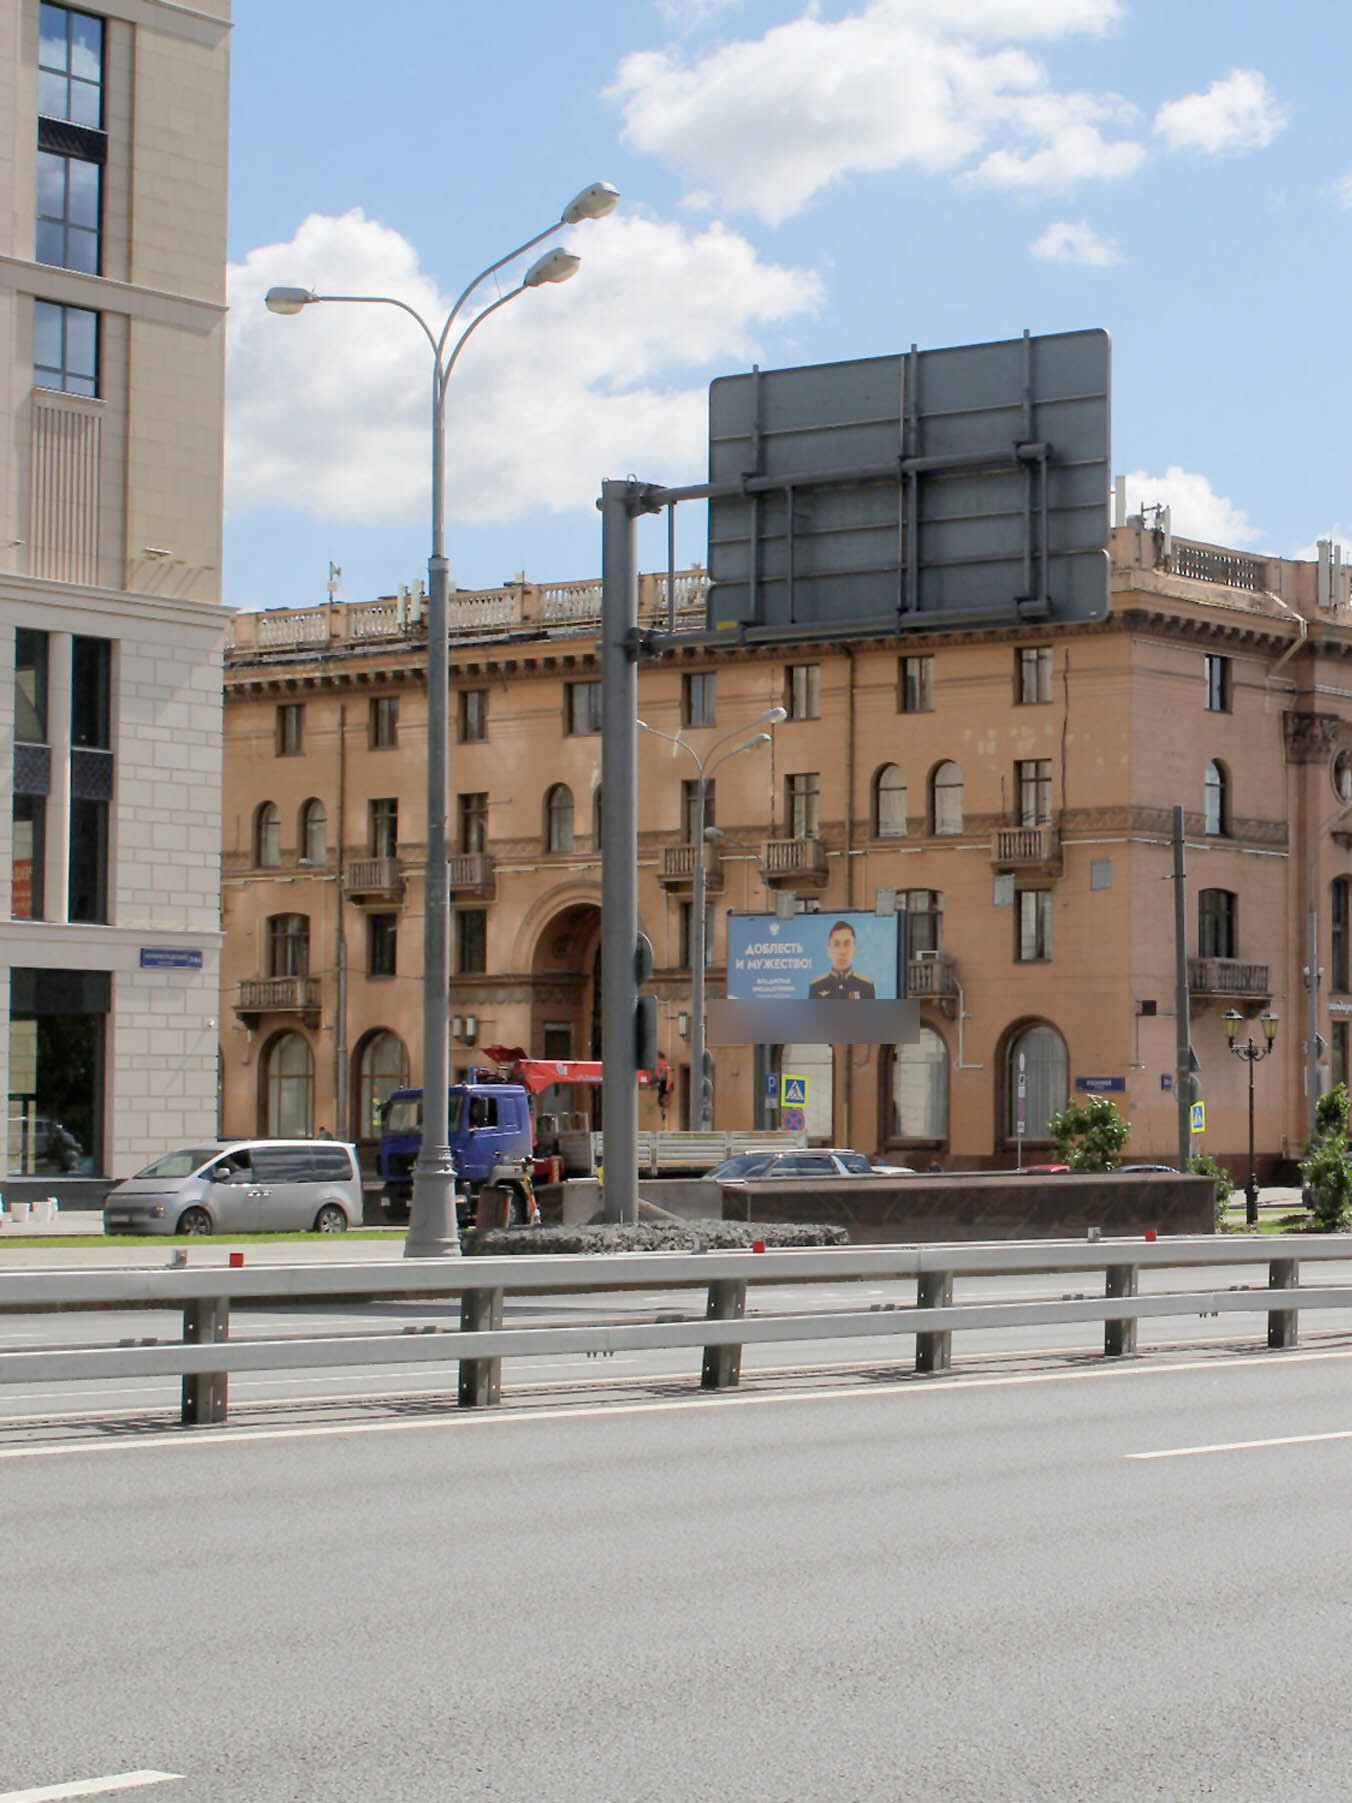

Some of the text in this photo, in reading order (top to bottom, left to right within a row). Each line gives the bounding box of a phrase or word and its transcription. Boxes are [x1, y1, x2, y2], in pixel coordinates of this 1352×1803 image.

[744, 943, 804, 956] ДОБЛЕСТЬ
[735, 957, 813, 970] И МУЖЕСТВО!
